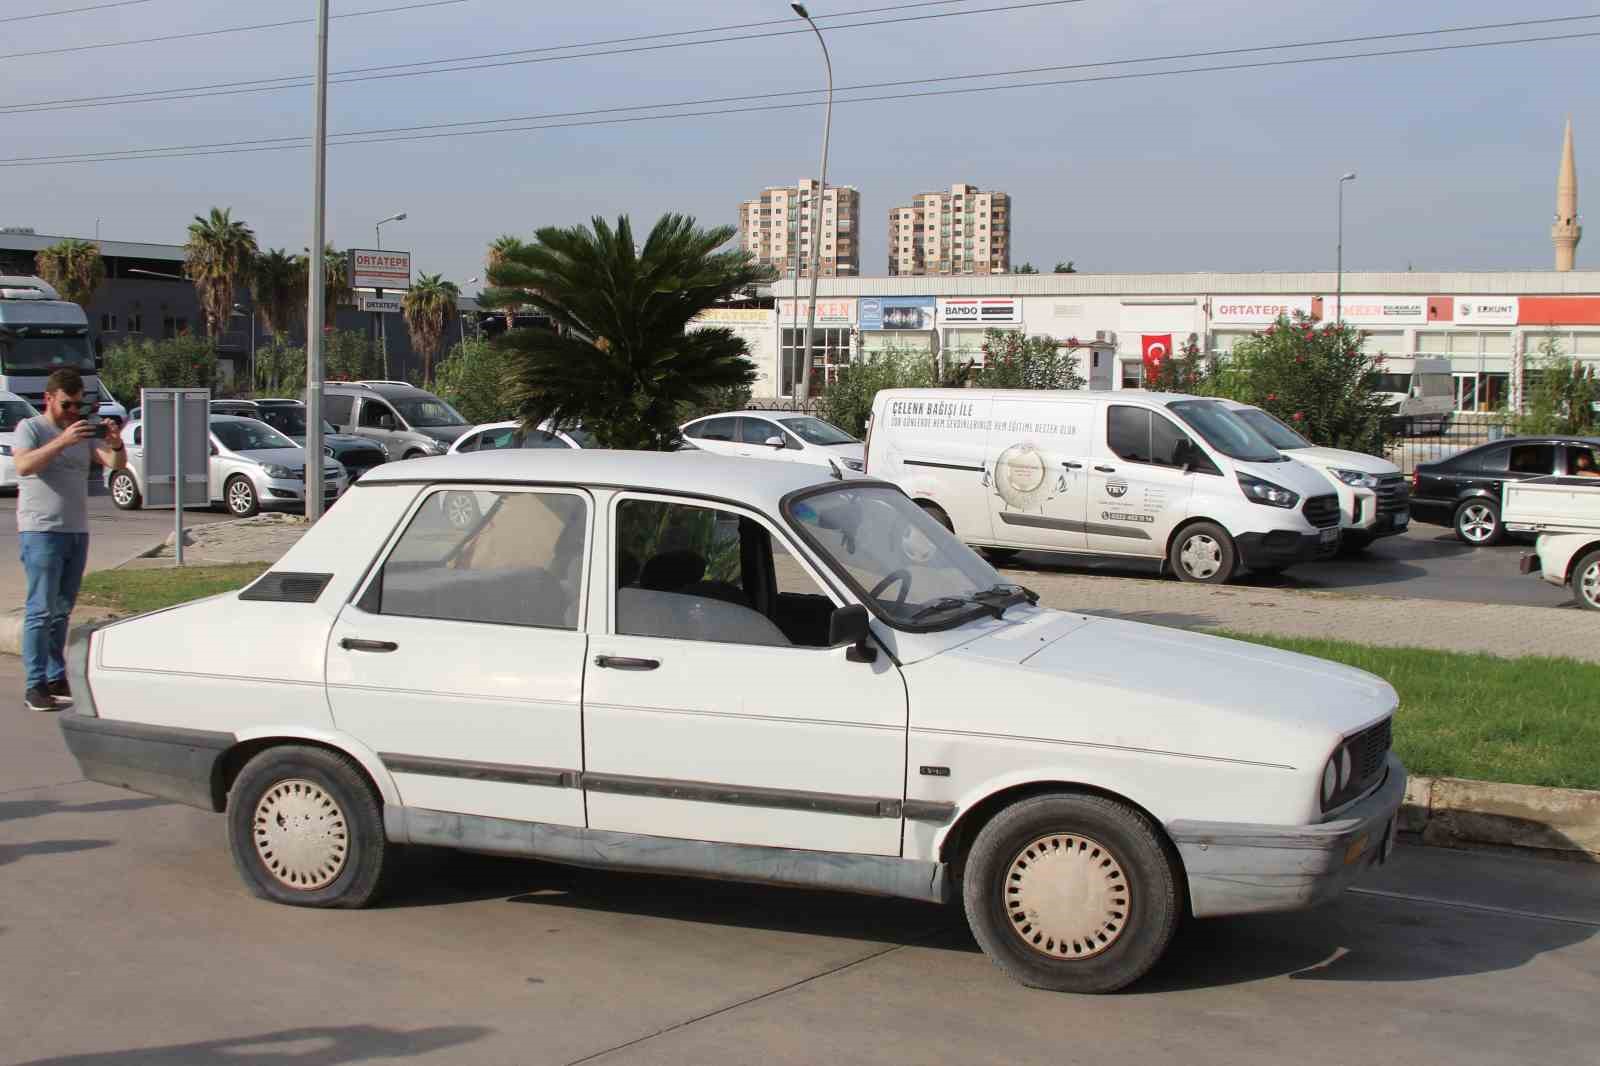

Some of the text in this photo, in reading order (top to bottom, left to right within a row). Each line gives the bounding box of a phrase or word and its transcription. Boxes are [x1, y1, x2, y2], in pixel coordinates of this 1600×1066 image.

[357, 255, 409, 267] ORTATEPE
[945, 307, 977, 315] BANDO
[1219, 304, 1288, 315] ORTATEPE
[892, 400, 974, 418] ÇELENK BAĞIŞI İLE
